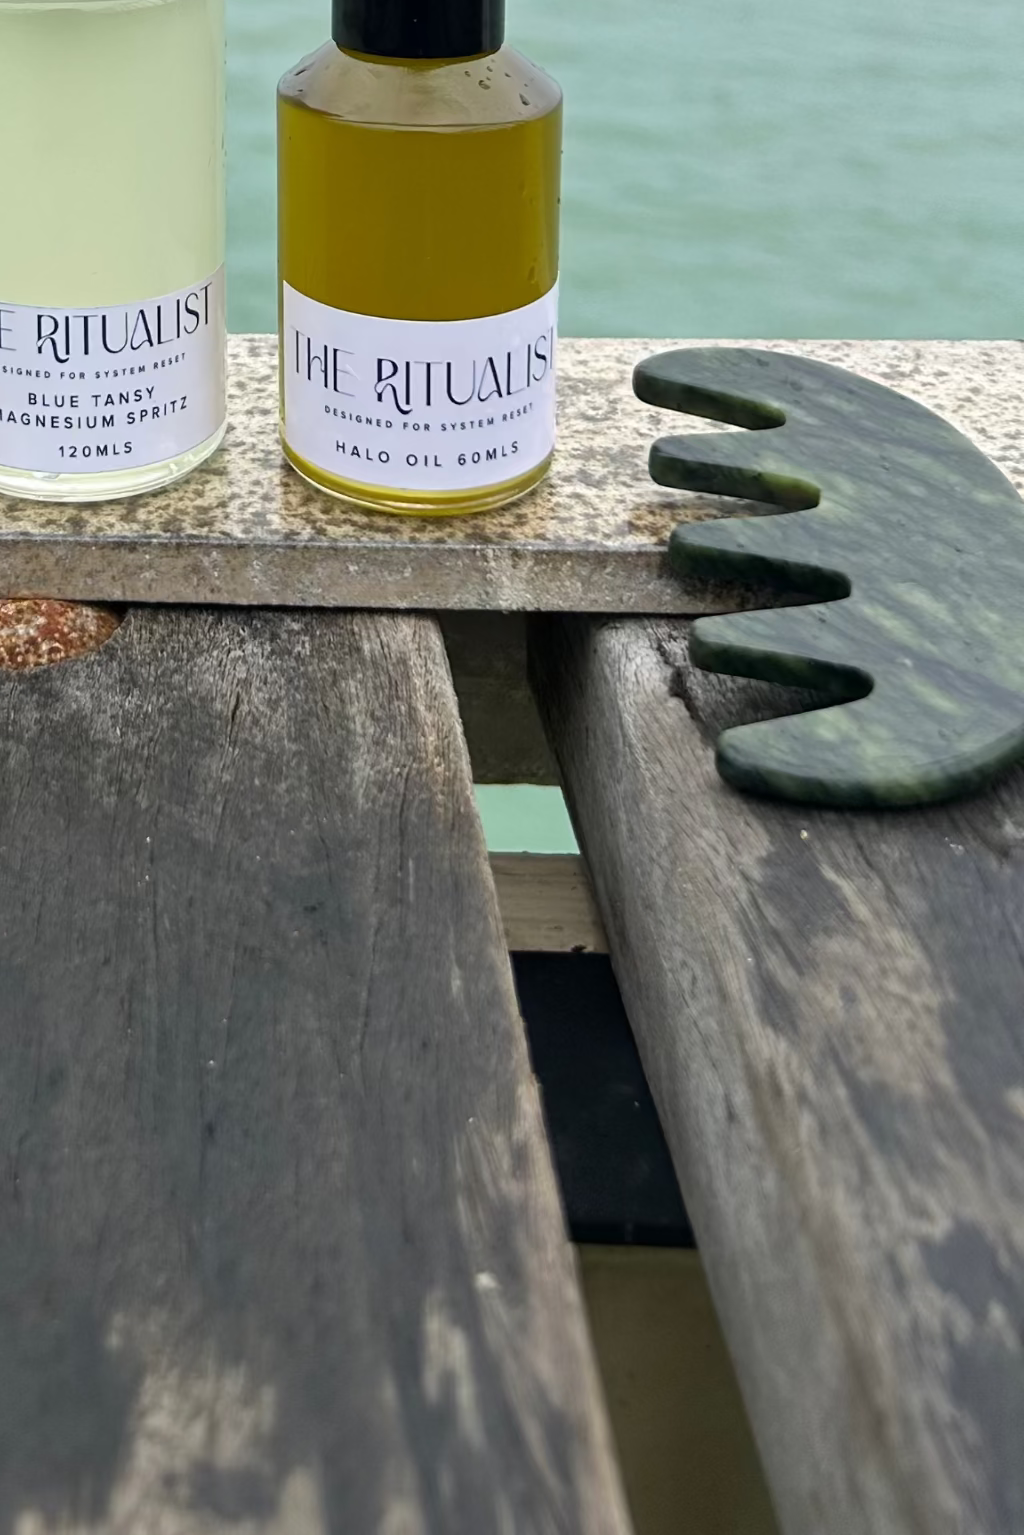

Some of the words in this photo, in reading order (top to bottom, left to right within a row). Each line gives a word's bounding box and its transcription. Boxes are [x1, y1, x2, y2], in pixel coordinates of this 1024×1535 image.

[36, 281, 213, 364] RITUALIST
[60, 371, 86, 380] FOR
[95, 364, 146, 380] SYSTEM
[153, 352, 187, 370] RESET
[290, 325, 356, 398] THE
[28, 392, 80, 408] BLUE
[91, 386, 156, 408] TANSY
[126, 395, 188, 426] SPRITZ
[324, 404, 393, 429] DESIGNED
[403, 421, 431, 432] FOR
[440, 417, 495, 432] SYSTEM
[502, 403, 534, 423] RESET
[58, 440, 134, 459] 120MLS
[335, 439, 391, 464] HALO
[406, 454, 443, 468] OIL
[457, 440, 520, 466] 60MLS
